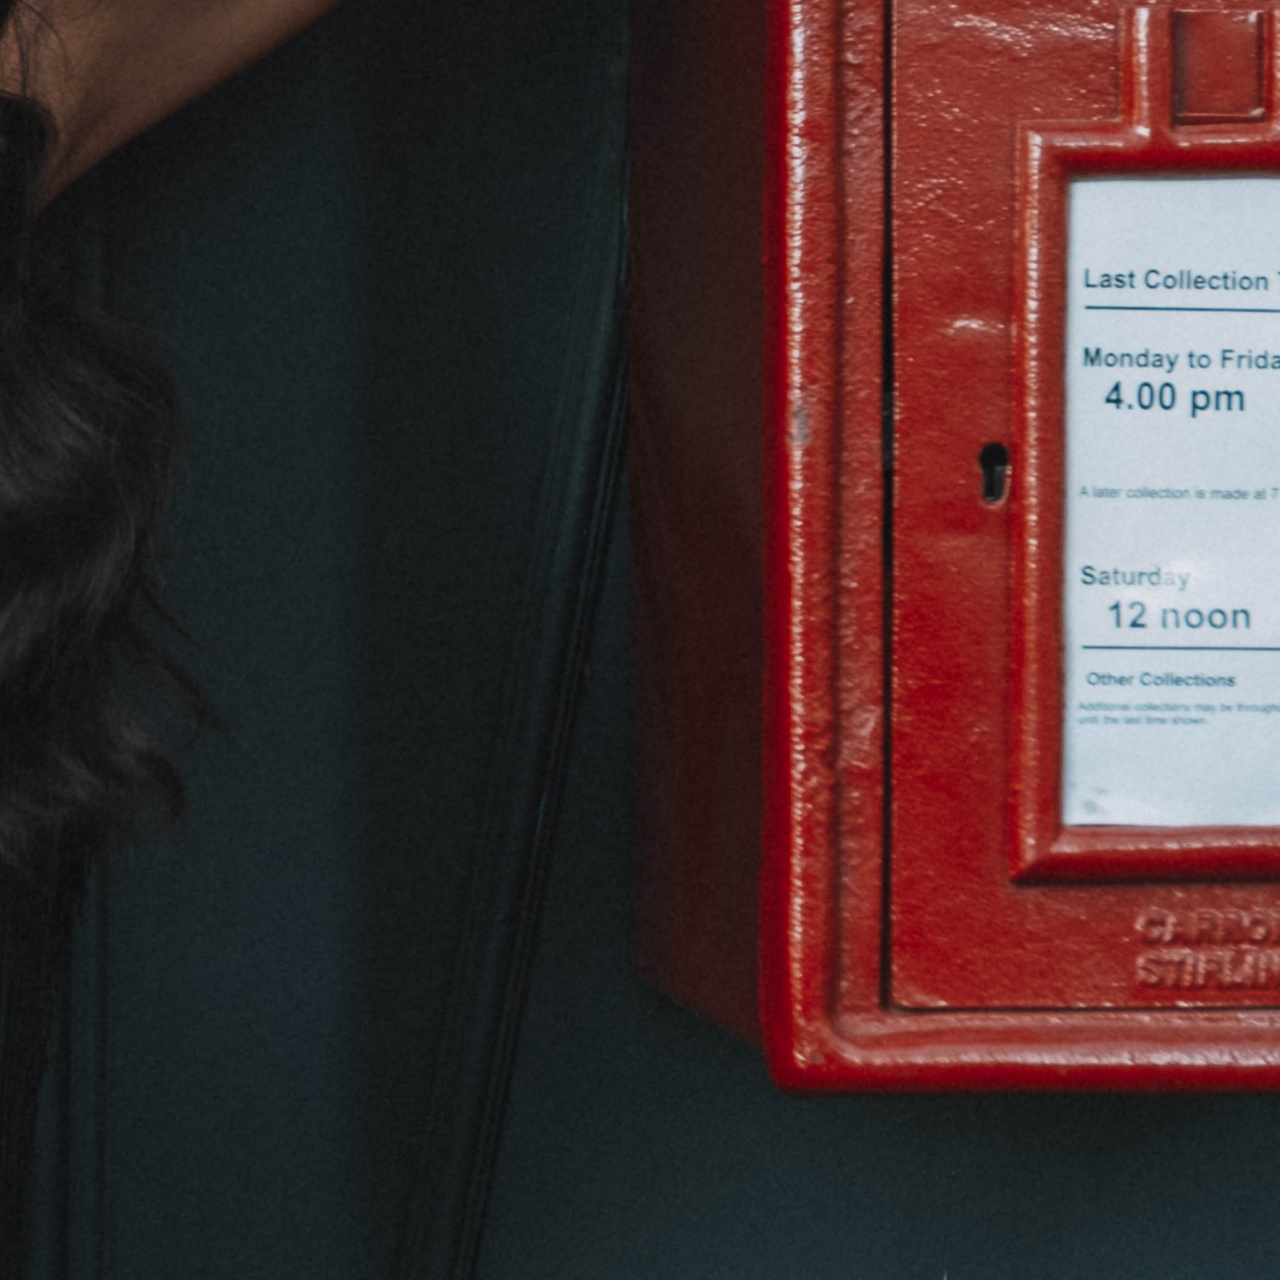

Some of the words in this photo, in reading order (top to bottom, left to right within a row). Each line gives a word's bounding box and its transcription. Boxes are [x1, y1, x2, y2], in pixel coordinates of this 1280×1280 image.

[1083, 268, 1136, 289] Last
[1144, 268, 1270, 291] Collection
[1083, 347, 1180, 374] Monday
[1188, 350, 1212, 369] to
[1104, 381, 1177, 410] 4.00
[1190, 388, 1246, 418] pm
[1092, 486, 1121, 499] later
[1125, 486, 1190, 500] collection
[1211, 488, 1249, 501] made
[1080, 564, 1191, 592] Saturday
[1108, 600, 1148, 629] 12
[1161, 607, 1251, 629] noon
[1086, 671, 1134, 686] Other
[1139, 671, 1237, 688] Collections
